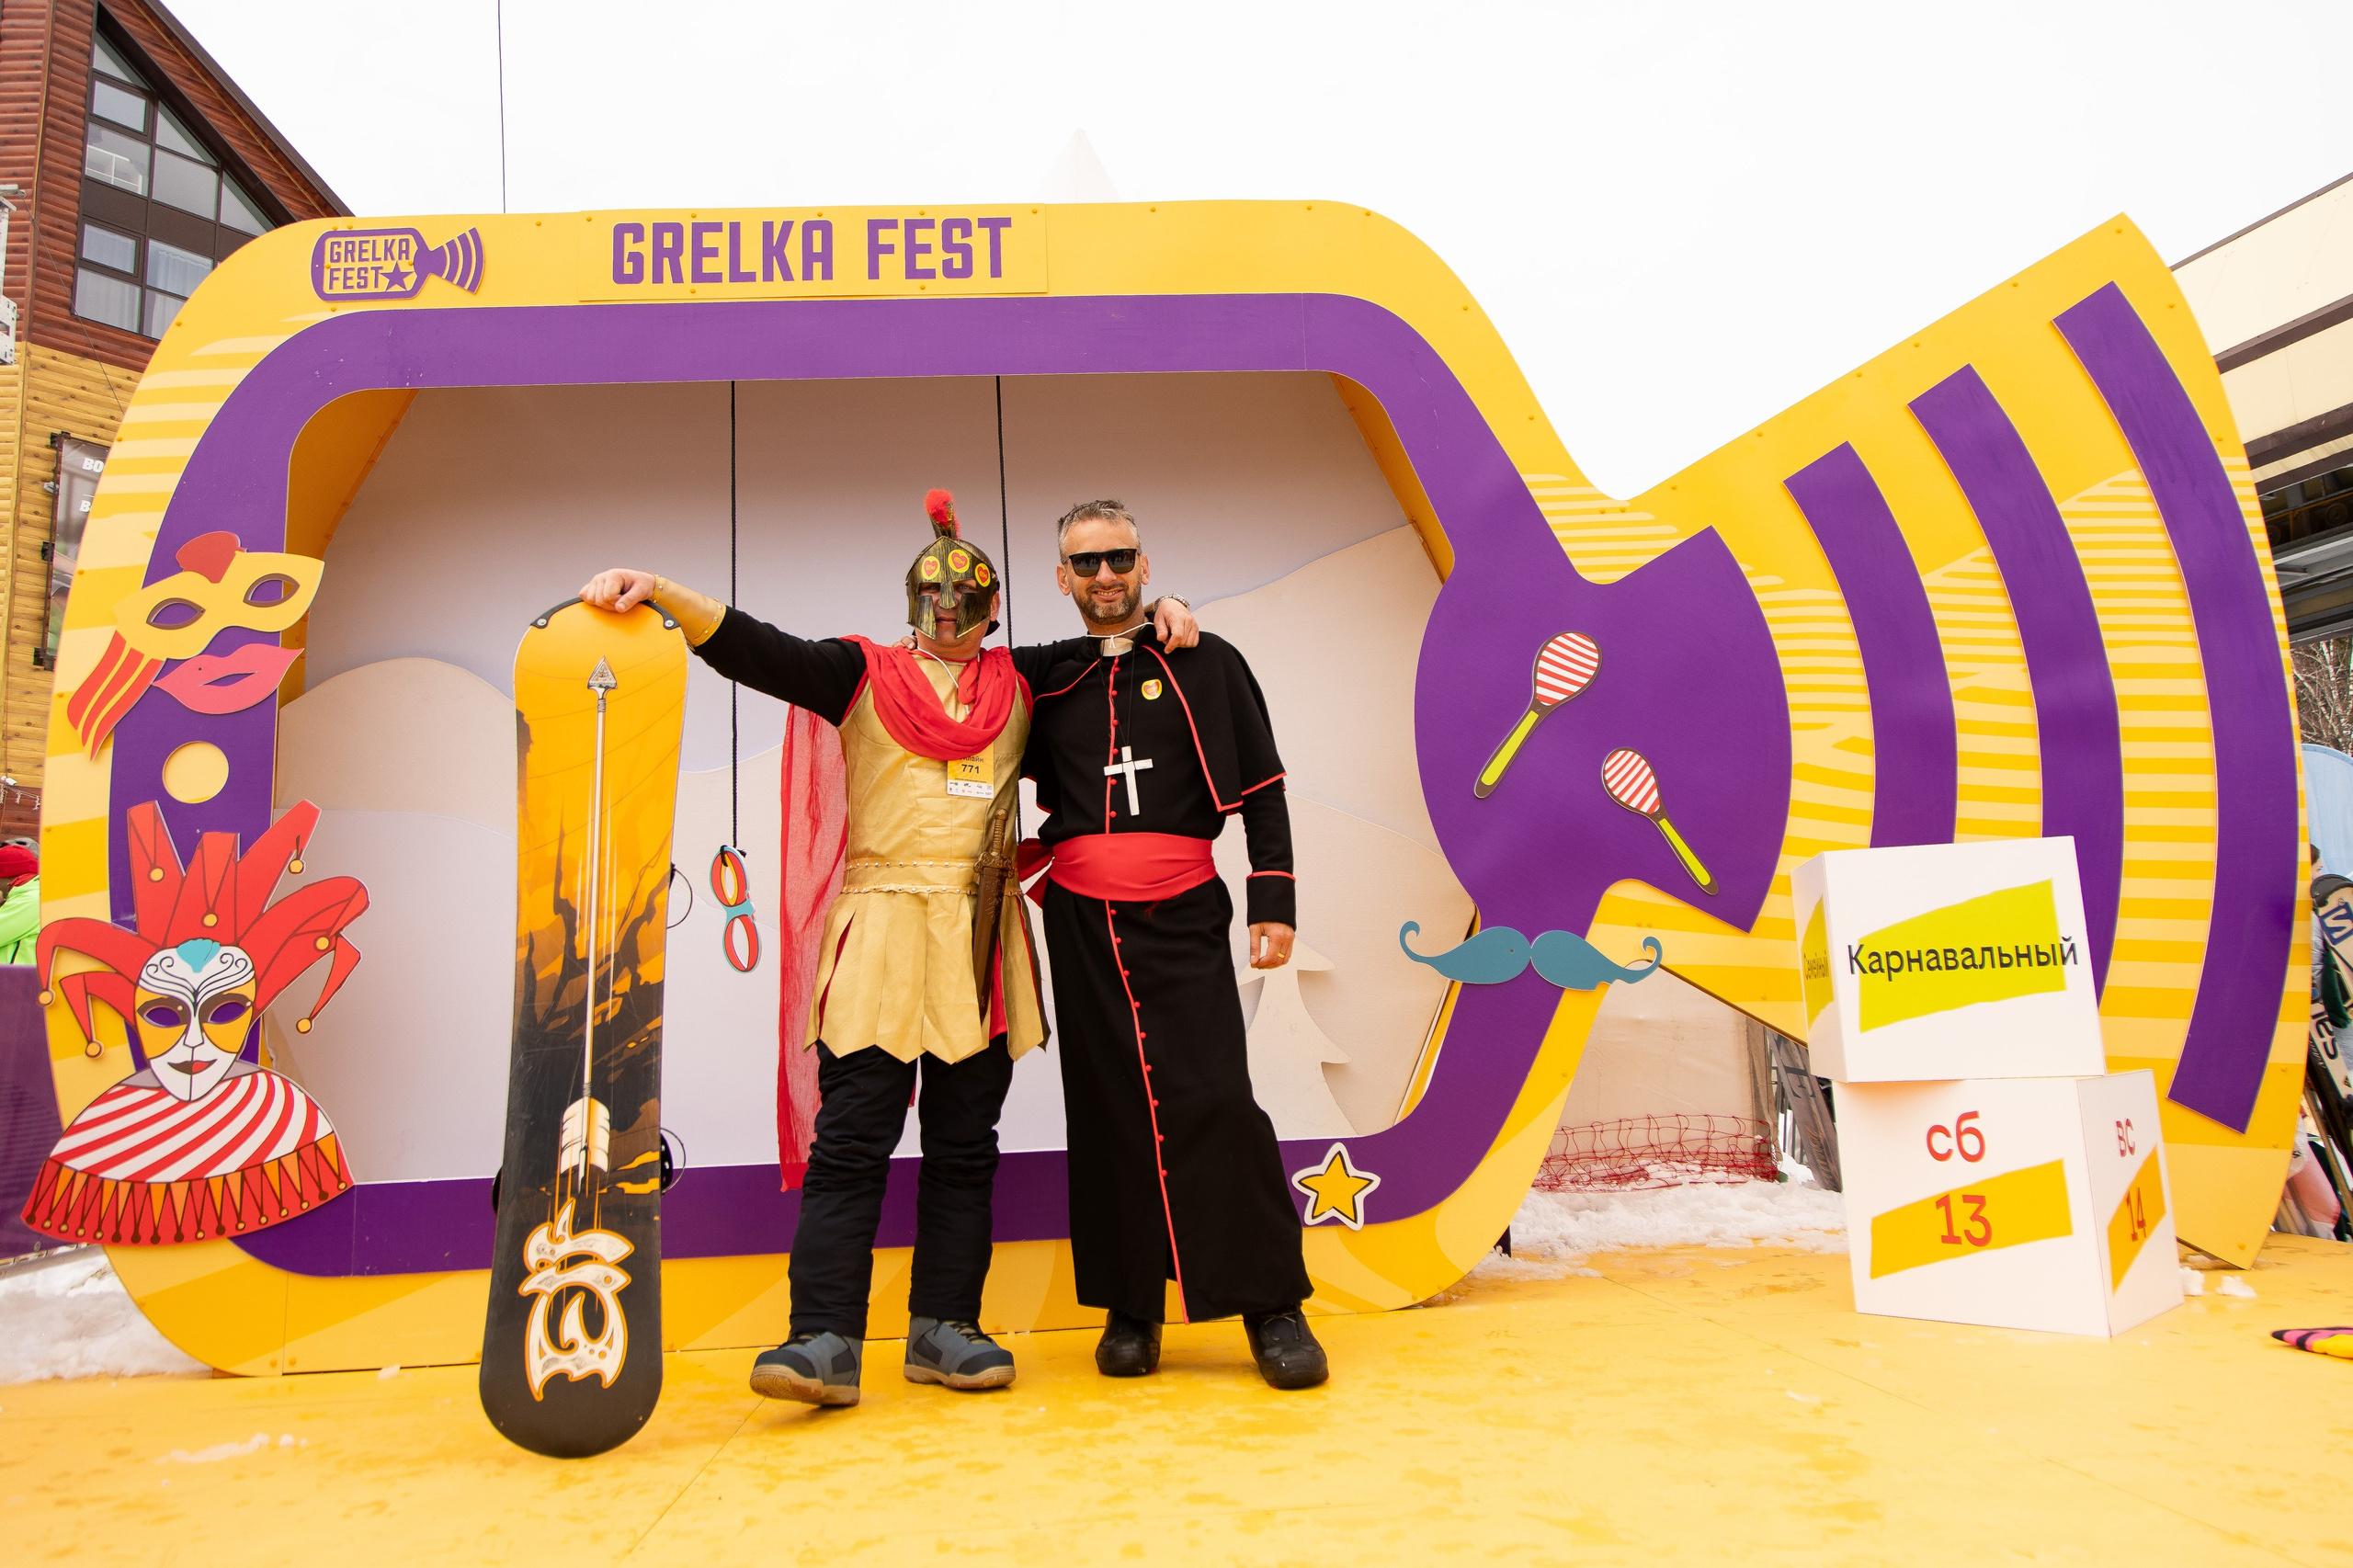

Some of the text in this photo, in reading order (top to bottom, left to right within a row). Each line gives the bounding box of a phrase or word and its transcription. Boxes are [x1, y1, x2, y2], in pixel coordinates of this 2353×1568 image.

[329, 238, 411, 264] GRELKA
[612, 217, 1012, 285] GRELKA FEST
[328, 267, 384, 290] FEST
[961, 764, 980, 774] 771
[1847, 936, 2079, 982] Карнавальный
[1927, 1110, 1986, 1163] сб
[2116, 1118, 2136, 1157] вс
[1935, 1193, 1993, 1247] 13
[2125, 1187, 2147, 1243] 14
